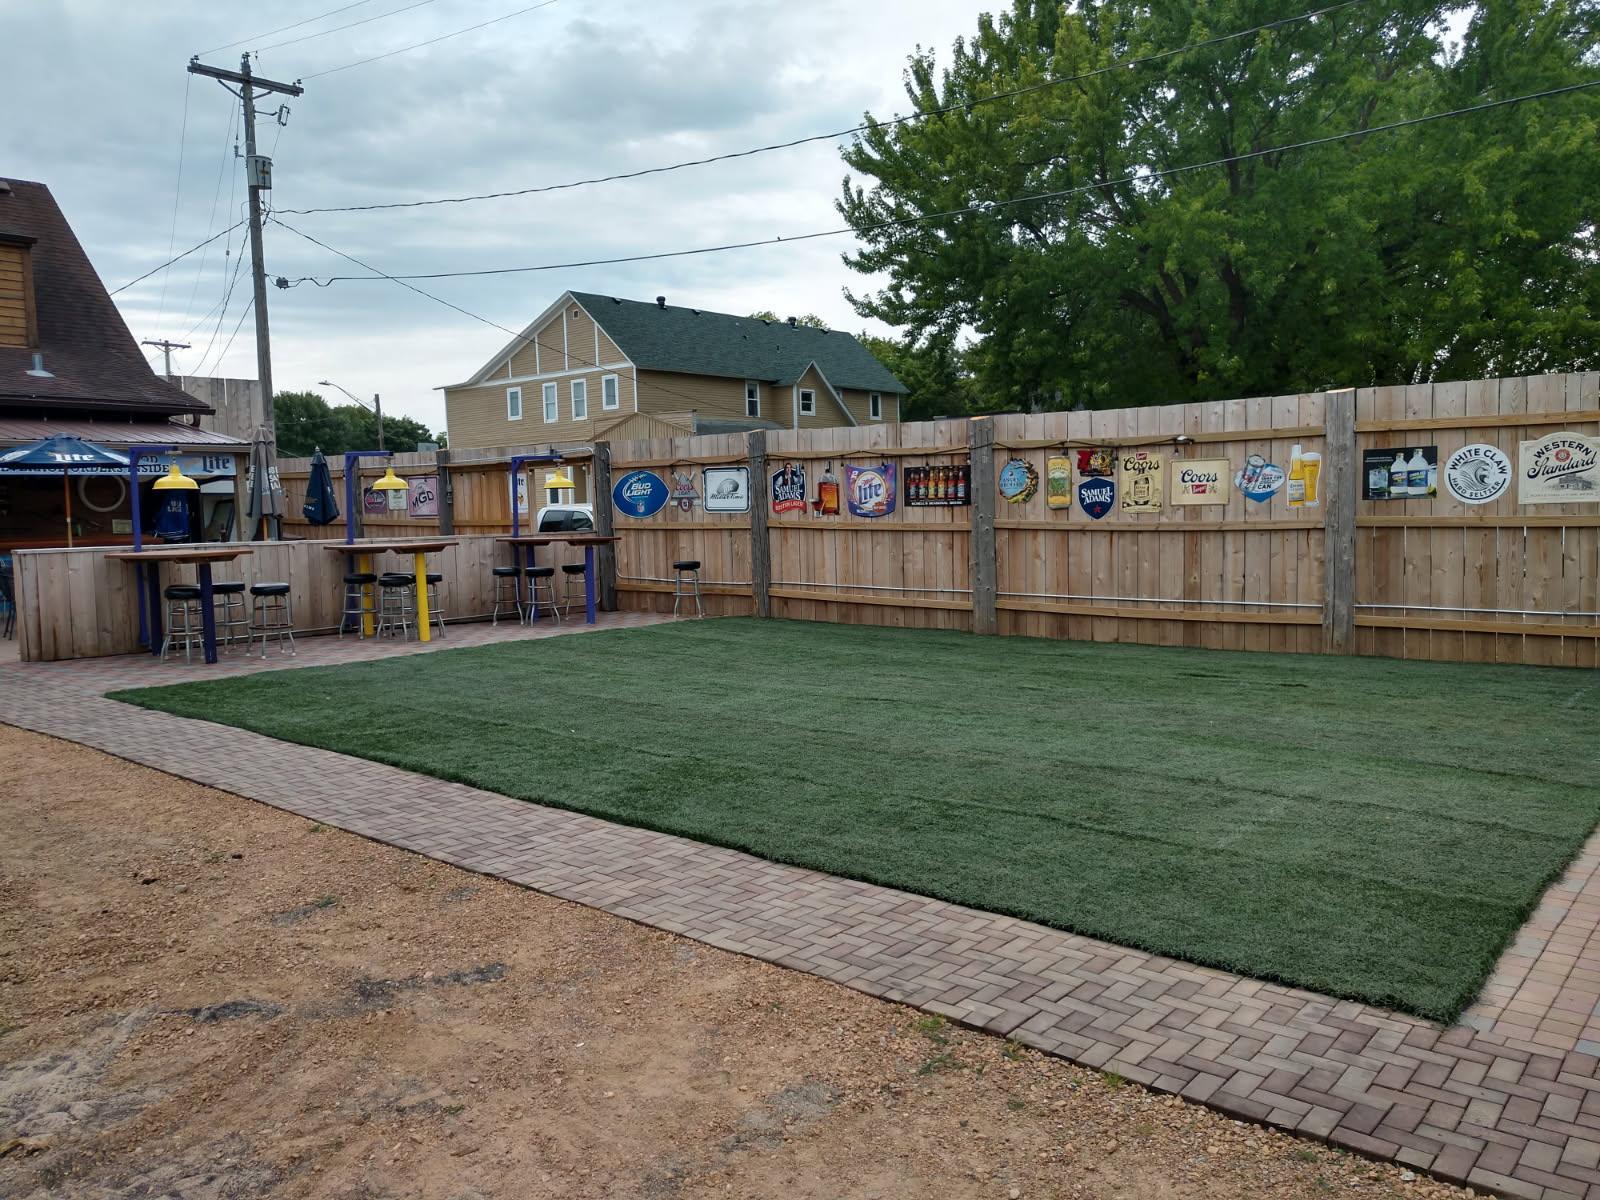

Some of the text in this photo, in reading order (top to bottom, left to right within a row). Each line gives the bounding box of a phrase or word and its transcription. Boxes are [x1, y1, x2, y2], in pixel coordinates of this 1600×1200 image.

[1533, 440, 1592, 459] WESTERN
[54, 453, 95, 462] Lite
[1123, 457, 1160, 471] Coors
[1449, 448, 1508, 475] WHITE CLAW
[202, 456, 230, 473] Lite
[1527, 451, 1597, 479] Standard
[1181, 470, 1218, 483] Coors
[631, 482, 651, 490] BUD
[775, 484, 803, 495] SAMUEL
[1081, 487, 1113, 497] SAMUEL
[1451, 477, 1501, 498] HARD SELTZER
[412, 490, 435, 509] MGD
[626, 489, 652, 497] LIGHT
[777, 492, 801, 502] ADAMS
[858, 483, 882, 505] Lite
[1083, 494, 1111, 504] ADAMS
